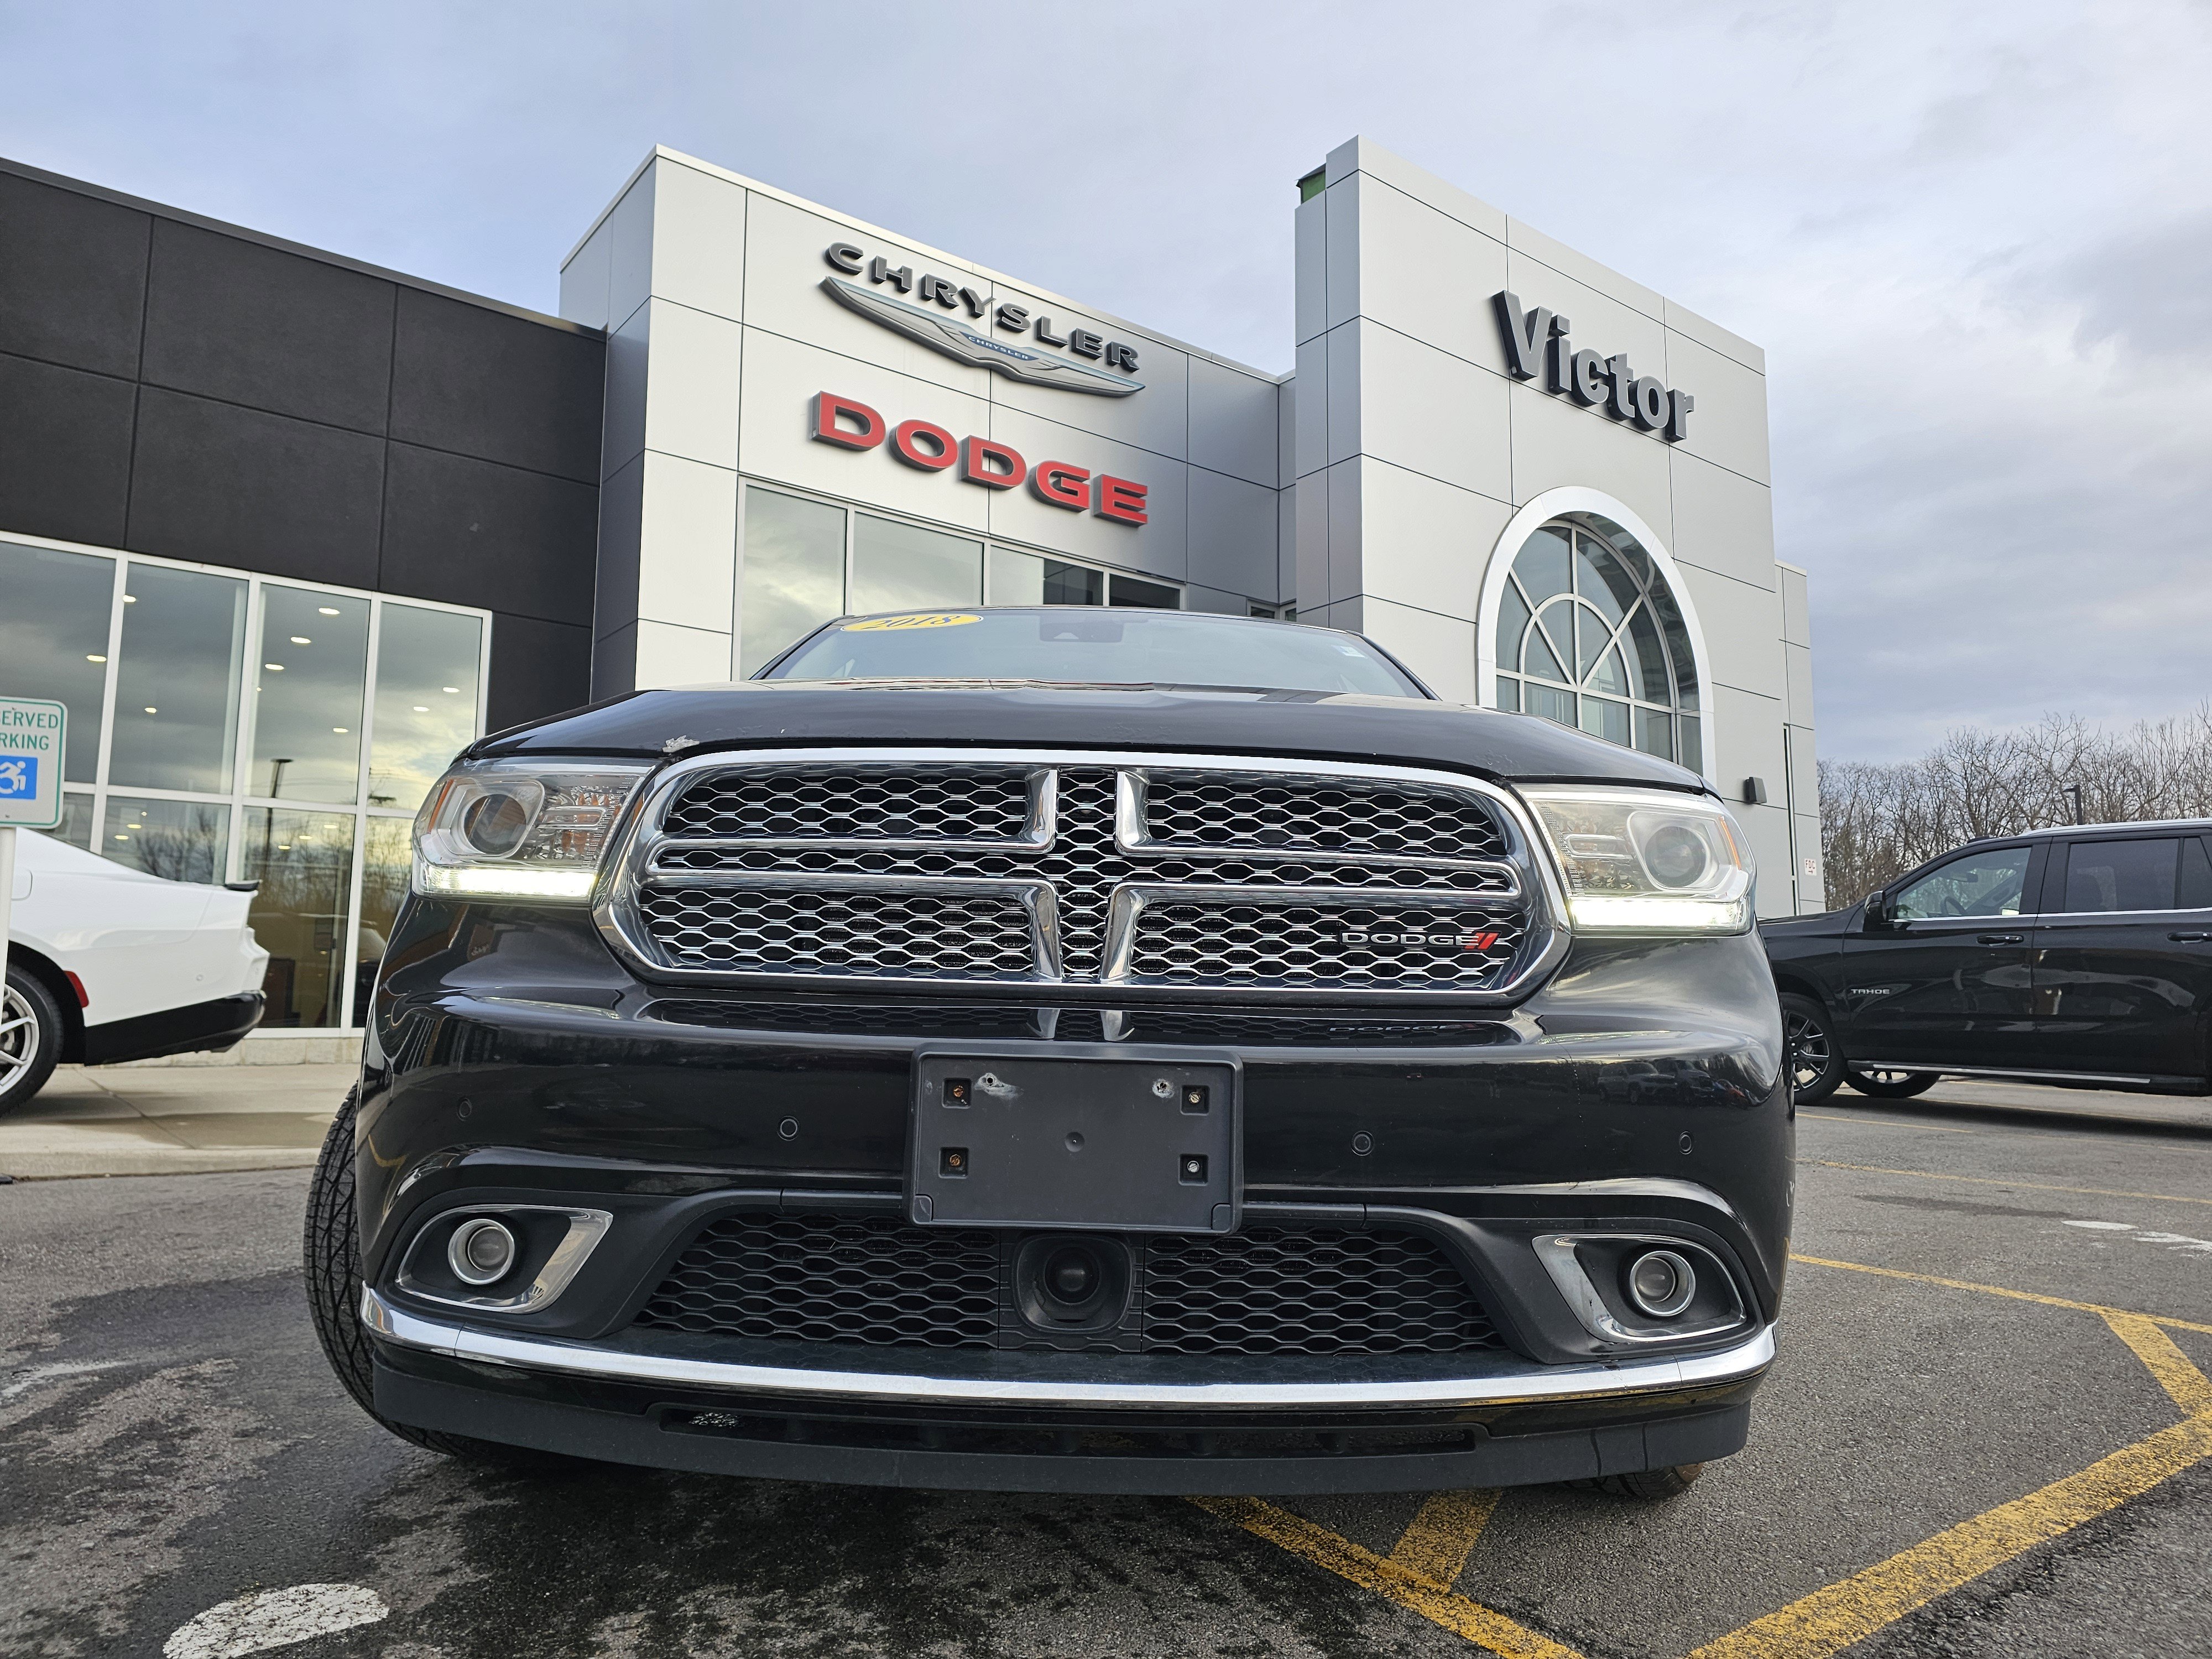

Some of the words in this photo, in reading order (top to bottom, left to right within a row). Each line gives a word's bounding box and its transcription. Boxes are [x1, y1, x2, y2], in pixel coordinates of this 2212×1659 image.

[825, 242, 1140, 373] CHRYSLER
[968, 336, 1029, 359] CHRYSLER
[1493, 290, 1694, 443] Victor
[811, 390, 1149, 528] DODGE
[861, 615, 961, 629] 2018
[0, 710, 59, 728] ERVED
[1805, 860, 1815, 869] FDC
[1342, 932, 1480, 946] DODGE
